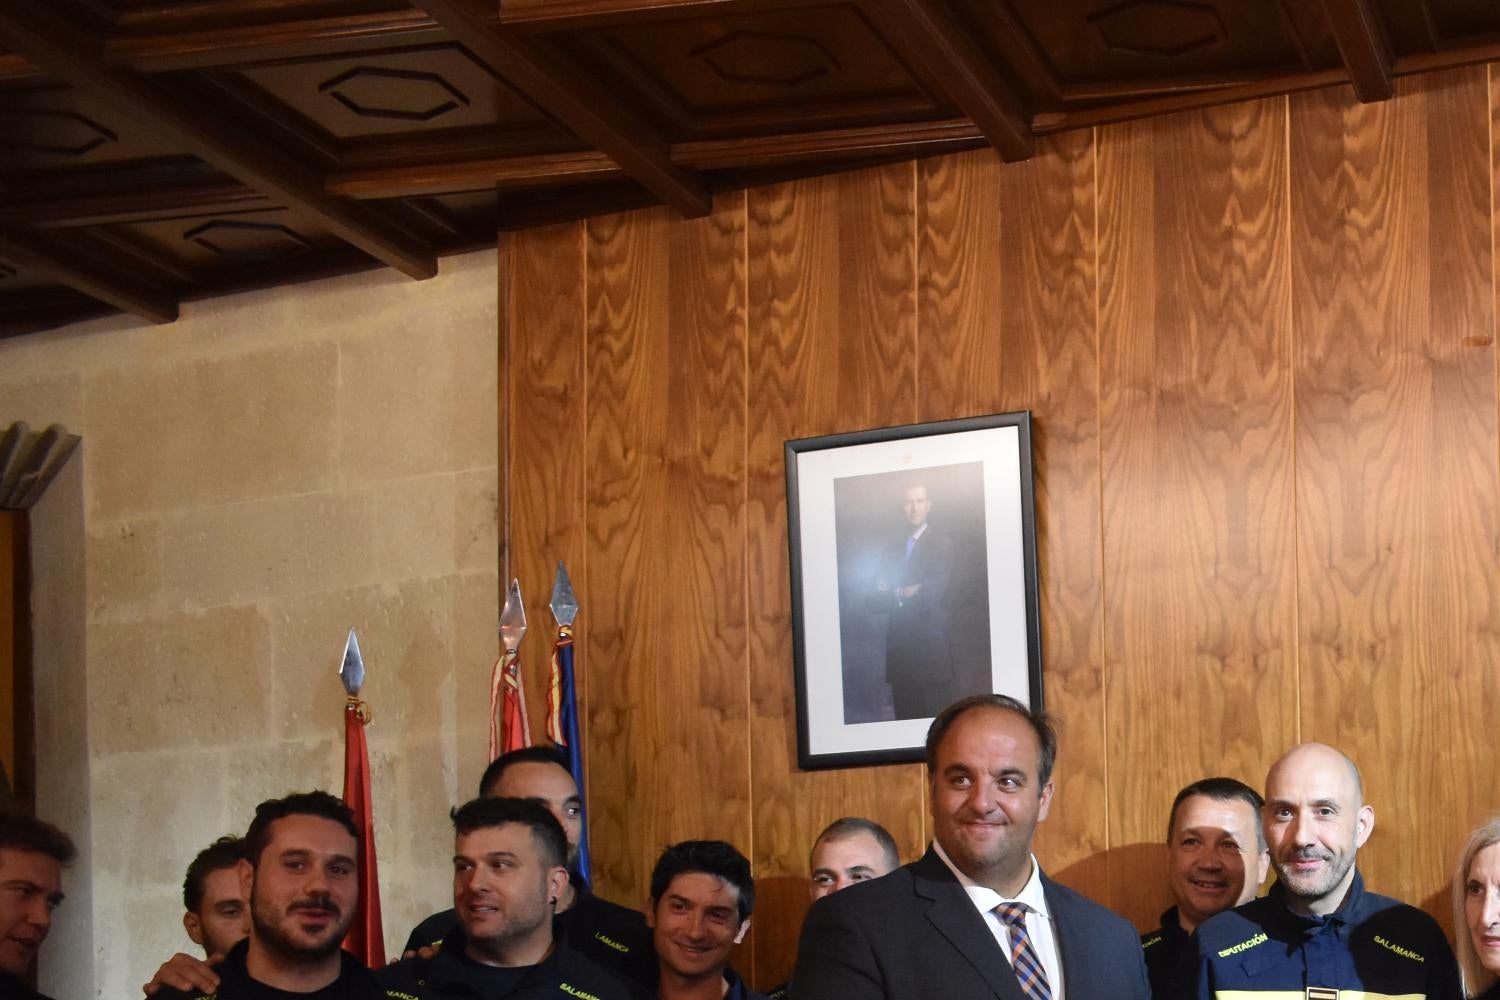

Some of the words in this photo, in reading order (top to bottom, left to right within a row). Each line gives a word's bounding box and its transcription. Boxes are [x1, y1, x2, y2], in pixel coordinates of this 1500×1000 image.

[595, 931, 629, 953] LAMANCA
[1218, 932, 1269, 958] DIPUTACIÓN
[1374, 935, 1424, 963] SALAMANCA
